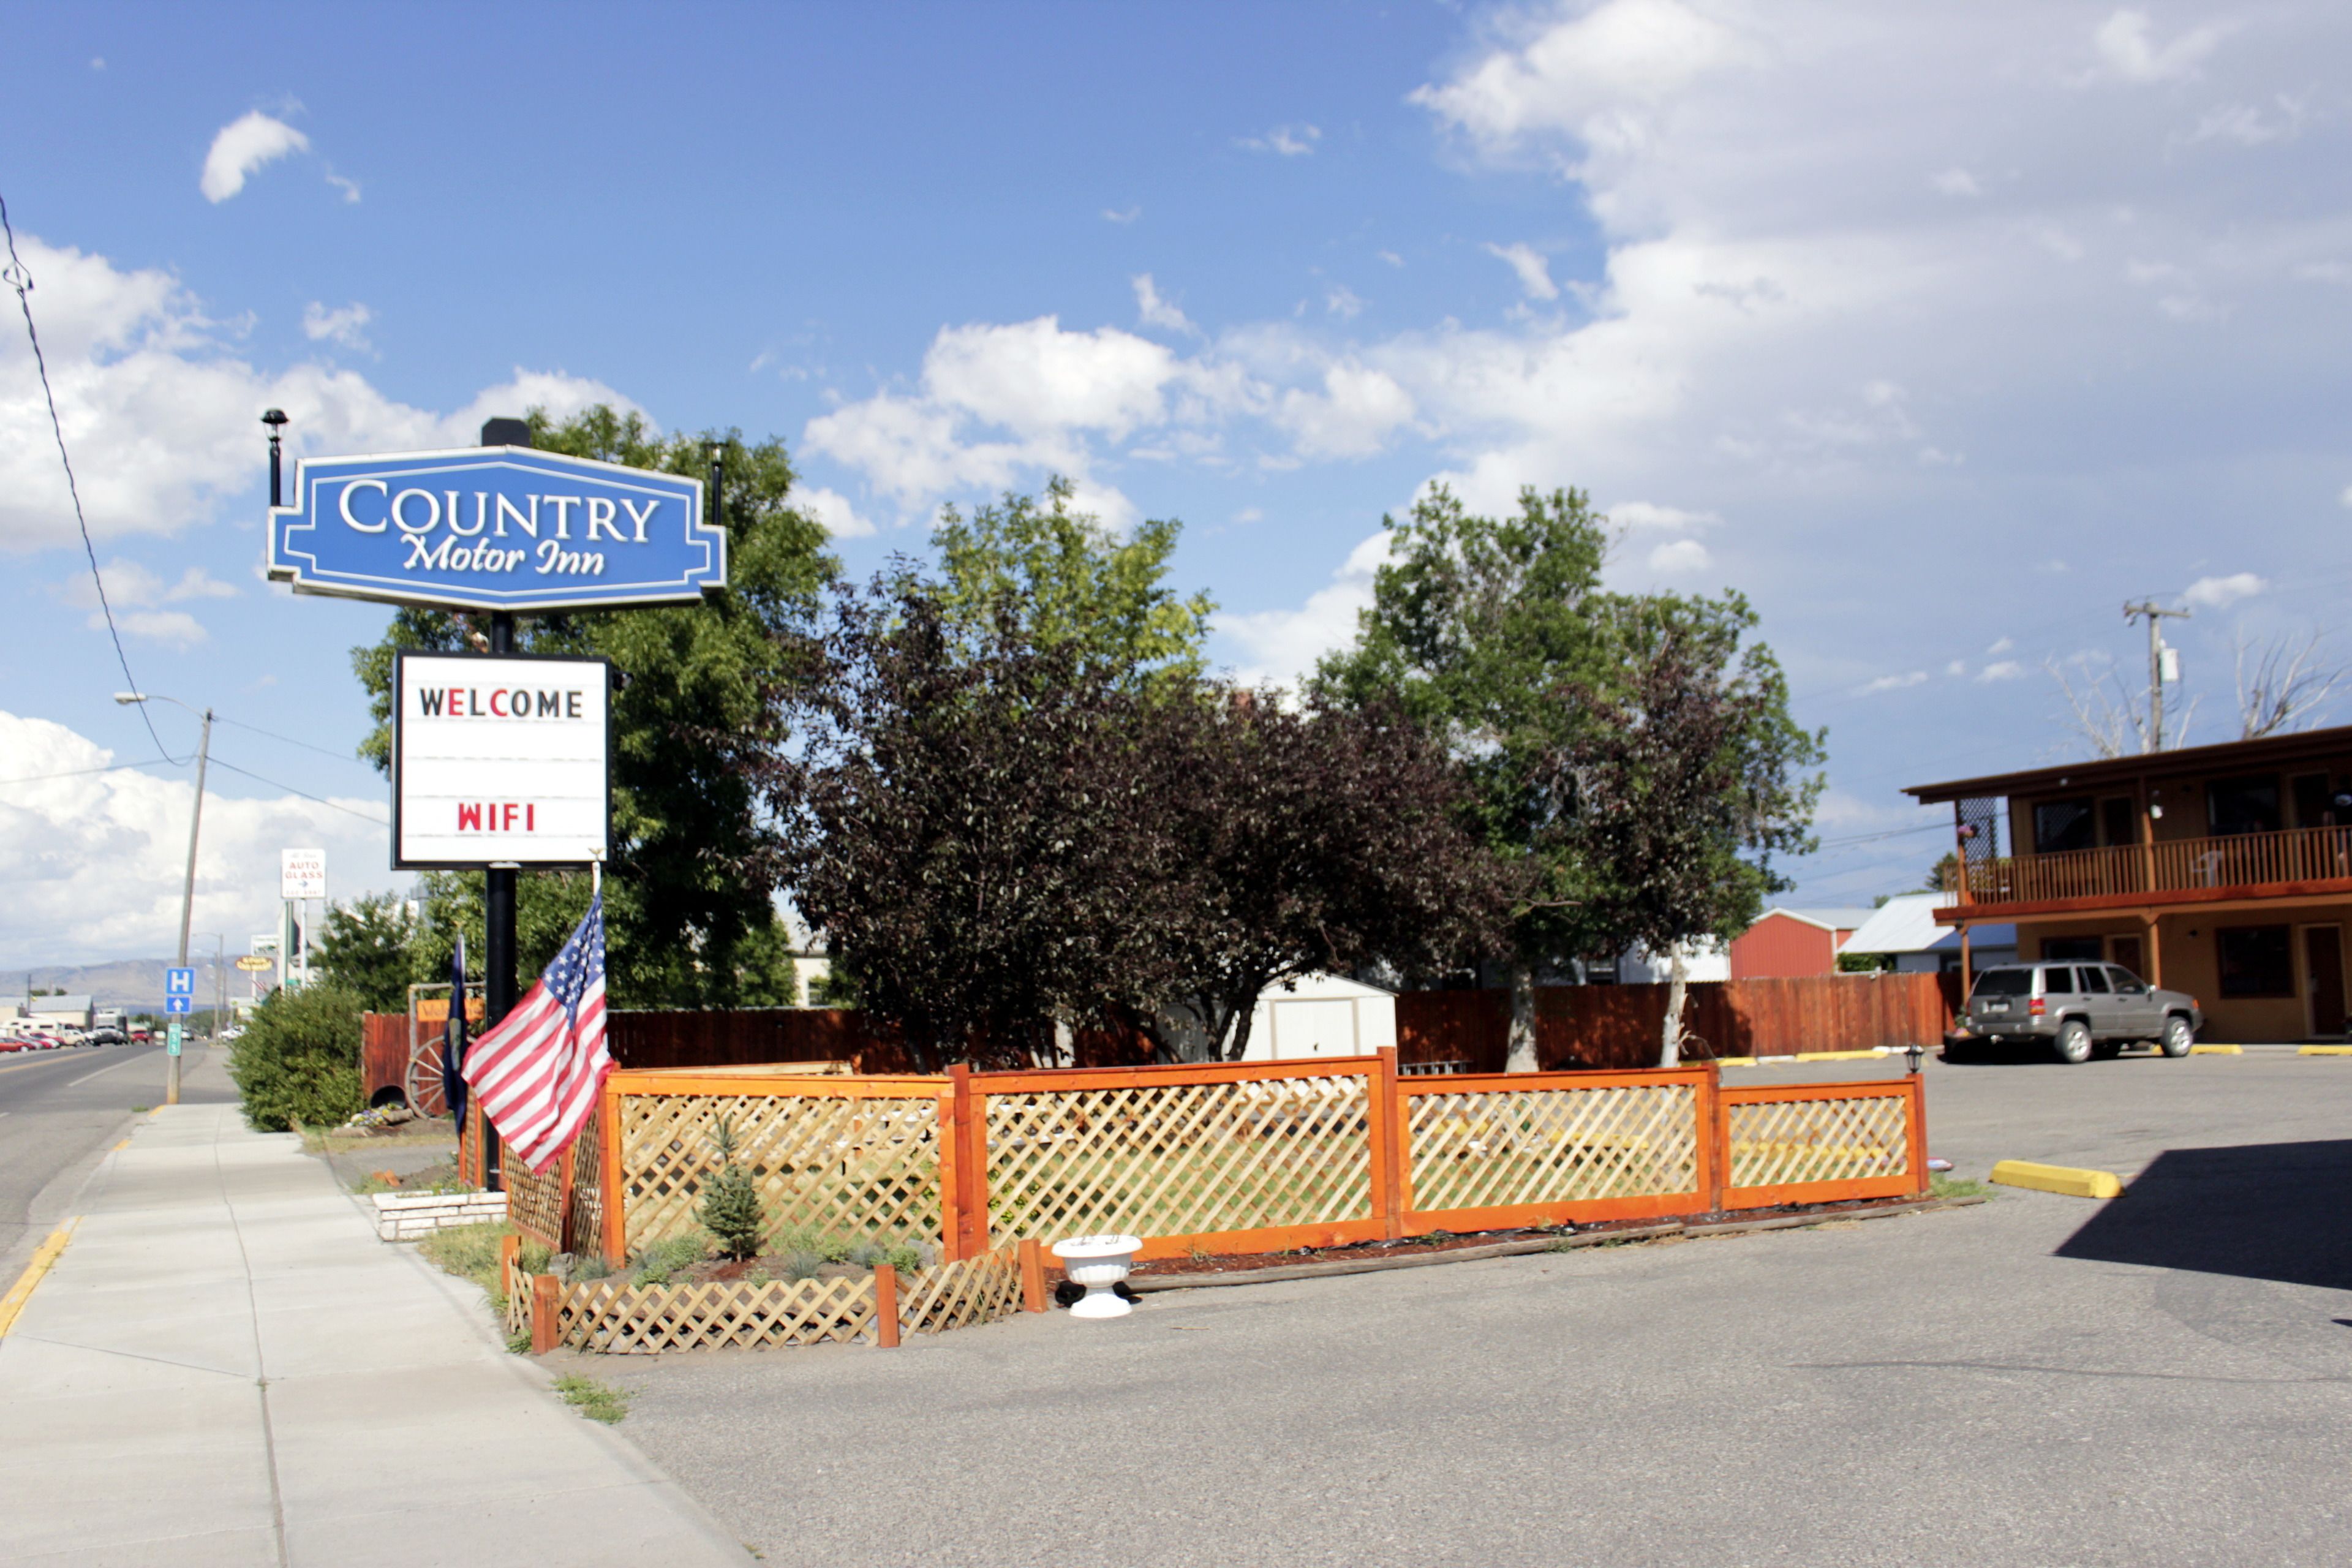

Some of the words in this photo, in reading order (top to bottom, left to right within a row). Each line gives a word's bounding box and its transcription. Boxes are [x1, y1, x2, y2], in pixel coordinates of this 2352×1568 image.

[339, 479, 661, 543] COUNTRY
[400, 533, 526, 572] Motor
[535, 539, 605, 576] Inn
[420, 688, 582, 718] WELCOME
[458, 802, 534, 831] WIFI
[171, 971, 189, 992] H
